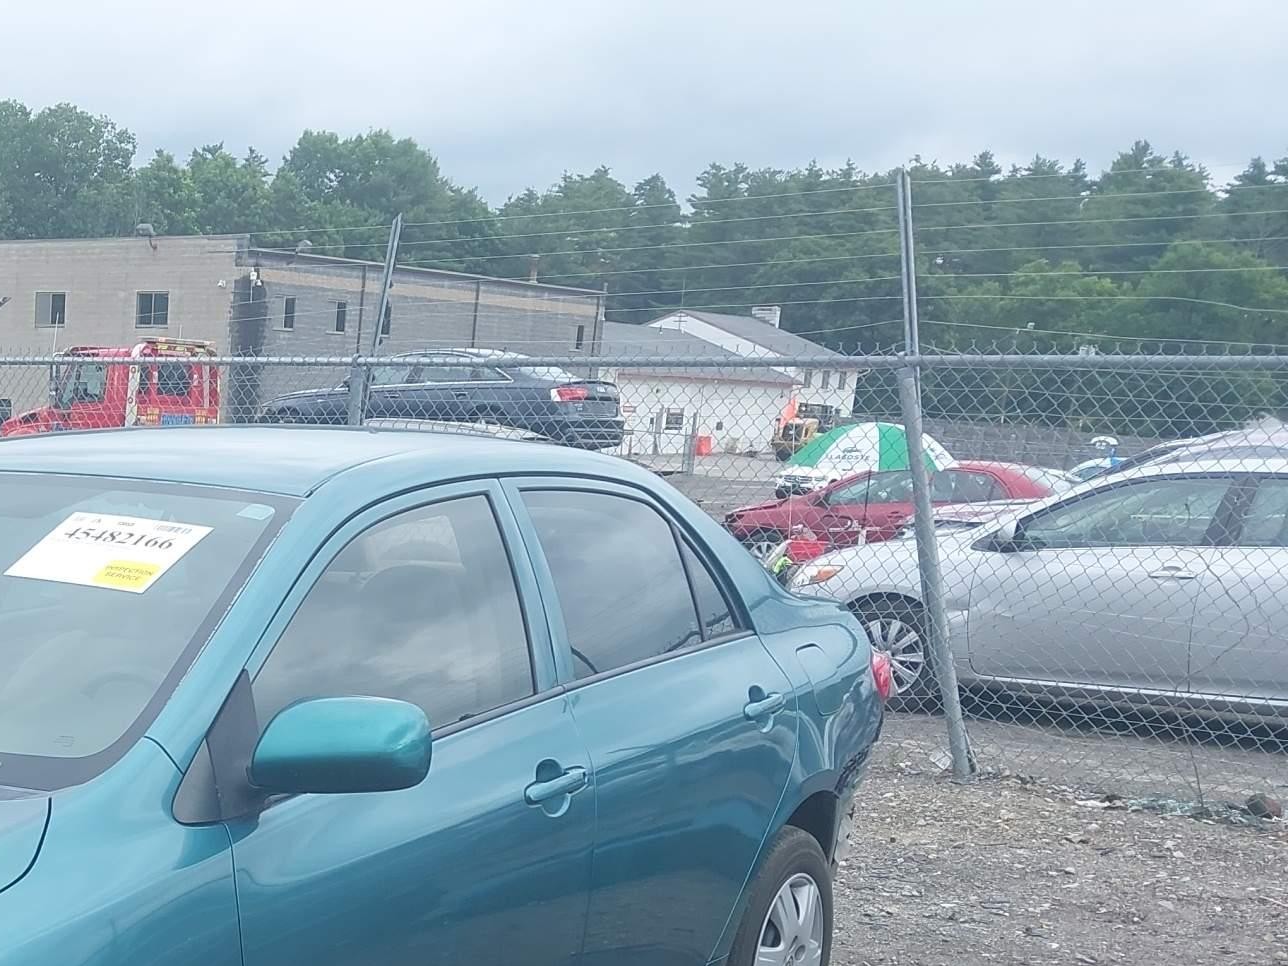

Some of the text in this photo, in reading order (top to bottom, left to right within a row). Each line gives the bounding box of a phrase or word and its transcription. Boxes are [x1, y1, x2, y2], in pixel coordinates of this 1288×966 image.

[828, 454, 871, 462] LACOSTE
[64, 527, 177, 550] 45482166
[105, 571, 141, 581] SERVICE
